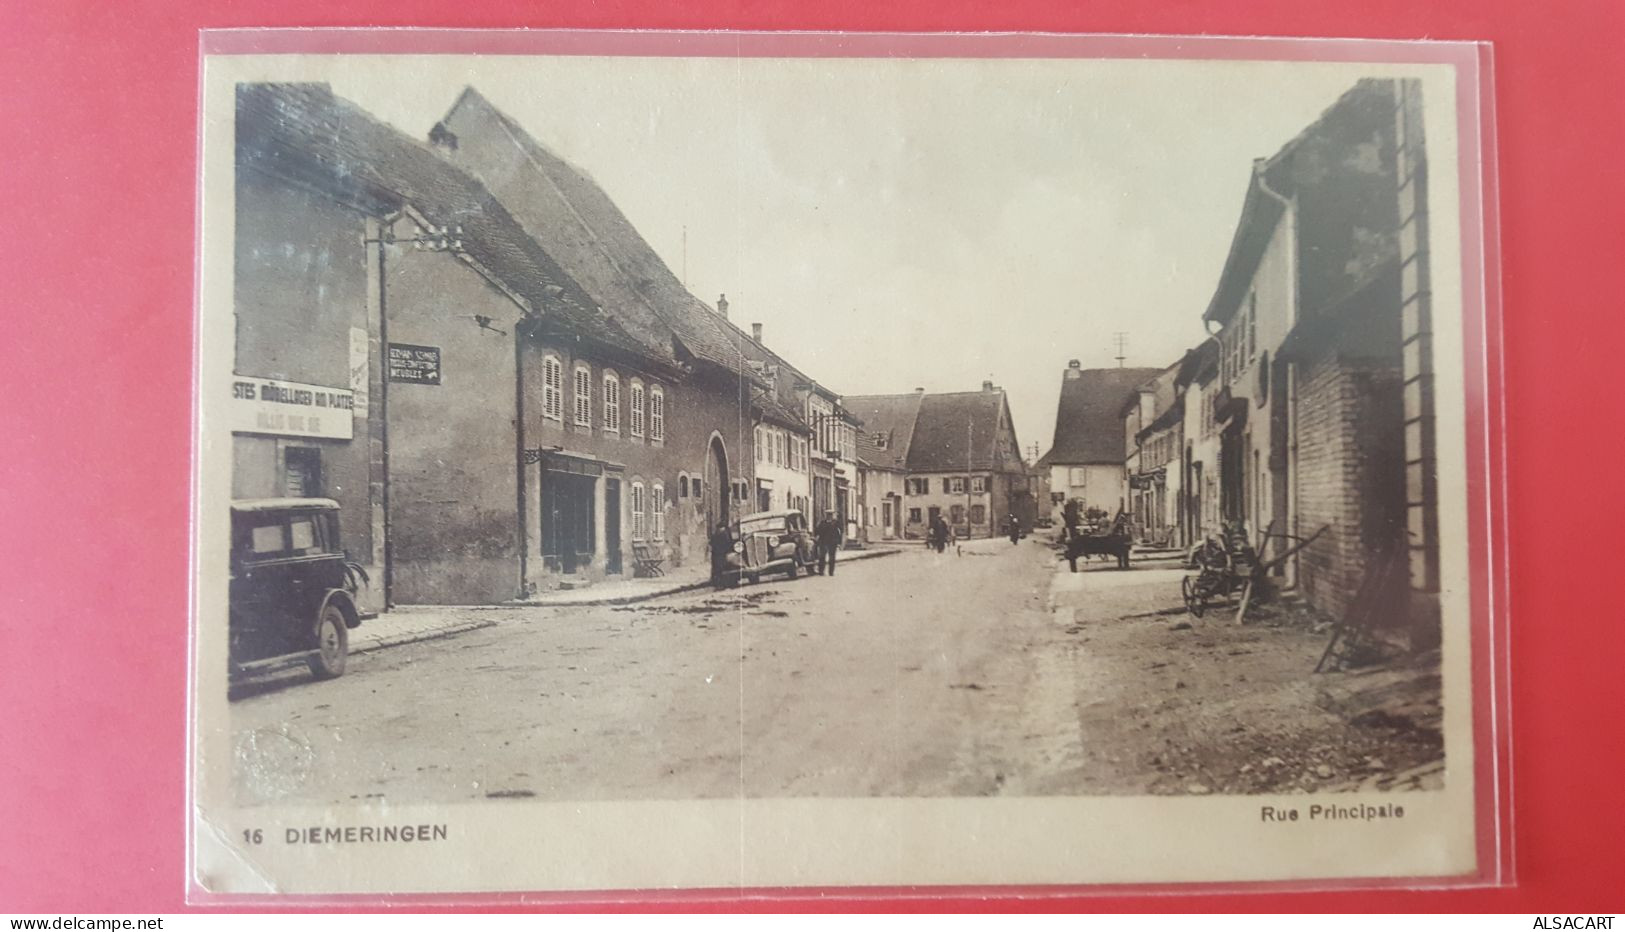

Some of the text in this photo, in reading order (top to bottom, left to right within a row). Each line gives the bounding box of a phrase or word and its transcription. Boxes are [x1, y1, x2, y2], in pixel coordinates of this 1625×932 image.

[1261, 803, 1405, 822] Rue Principale
[243, 825, 448, 845] 16 DIEMERINGEN
